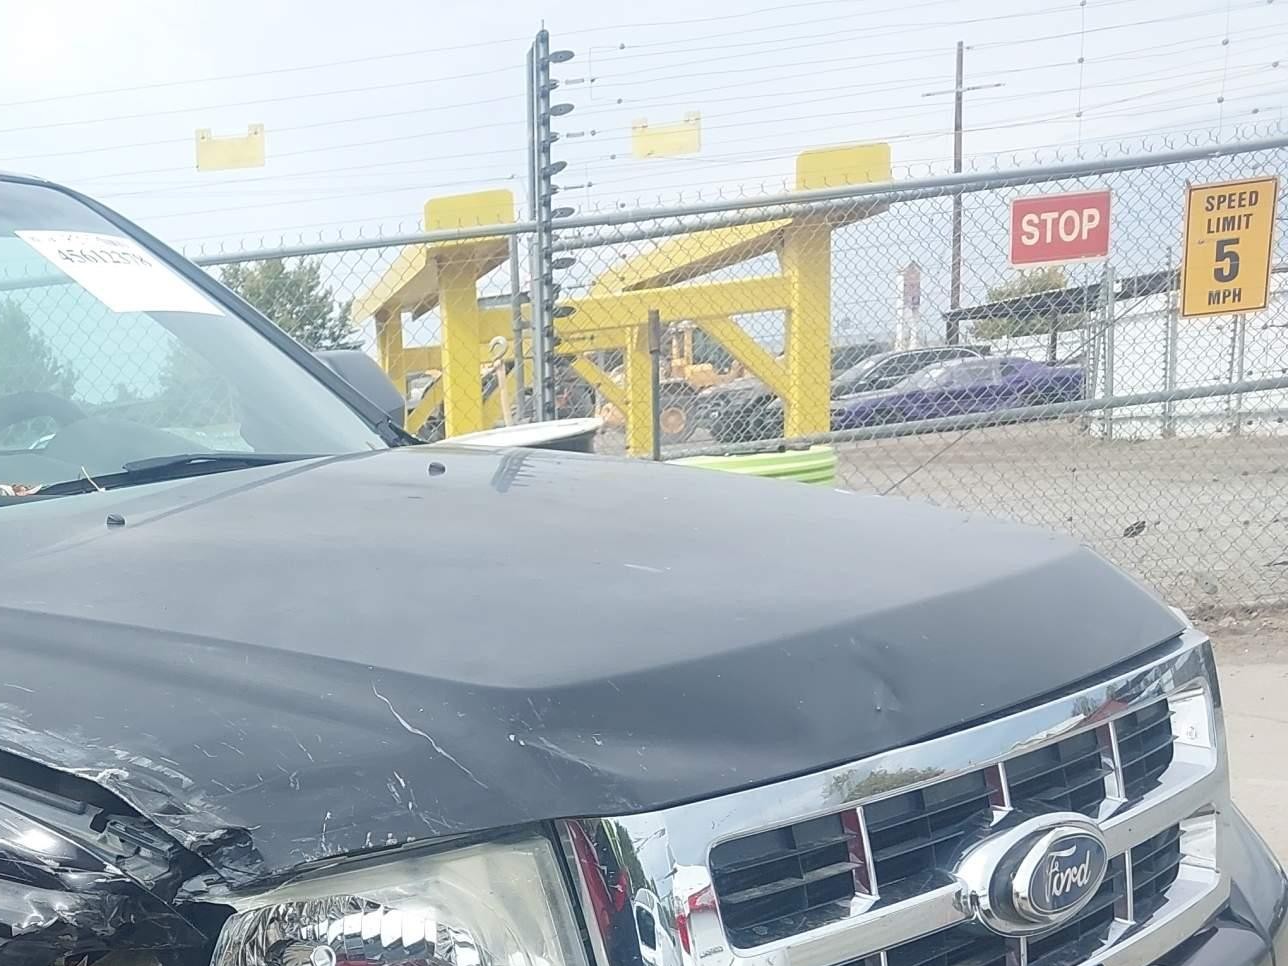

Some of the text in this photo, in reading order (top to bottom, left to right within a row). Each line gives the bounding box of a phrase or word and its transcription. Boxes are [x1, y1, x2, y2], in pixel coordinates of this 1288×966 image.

[1205, 190, 1259, 212] SPEED
[1020, 208, 1101, 246] STOP
[1207, 213, 1254, 234] LIMIT
[1213, 237, 1241, 283] 5
[1208, 287, 1243, 306] MPH
[1044, 844, 1092, 904] Ford
